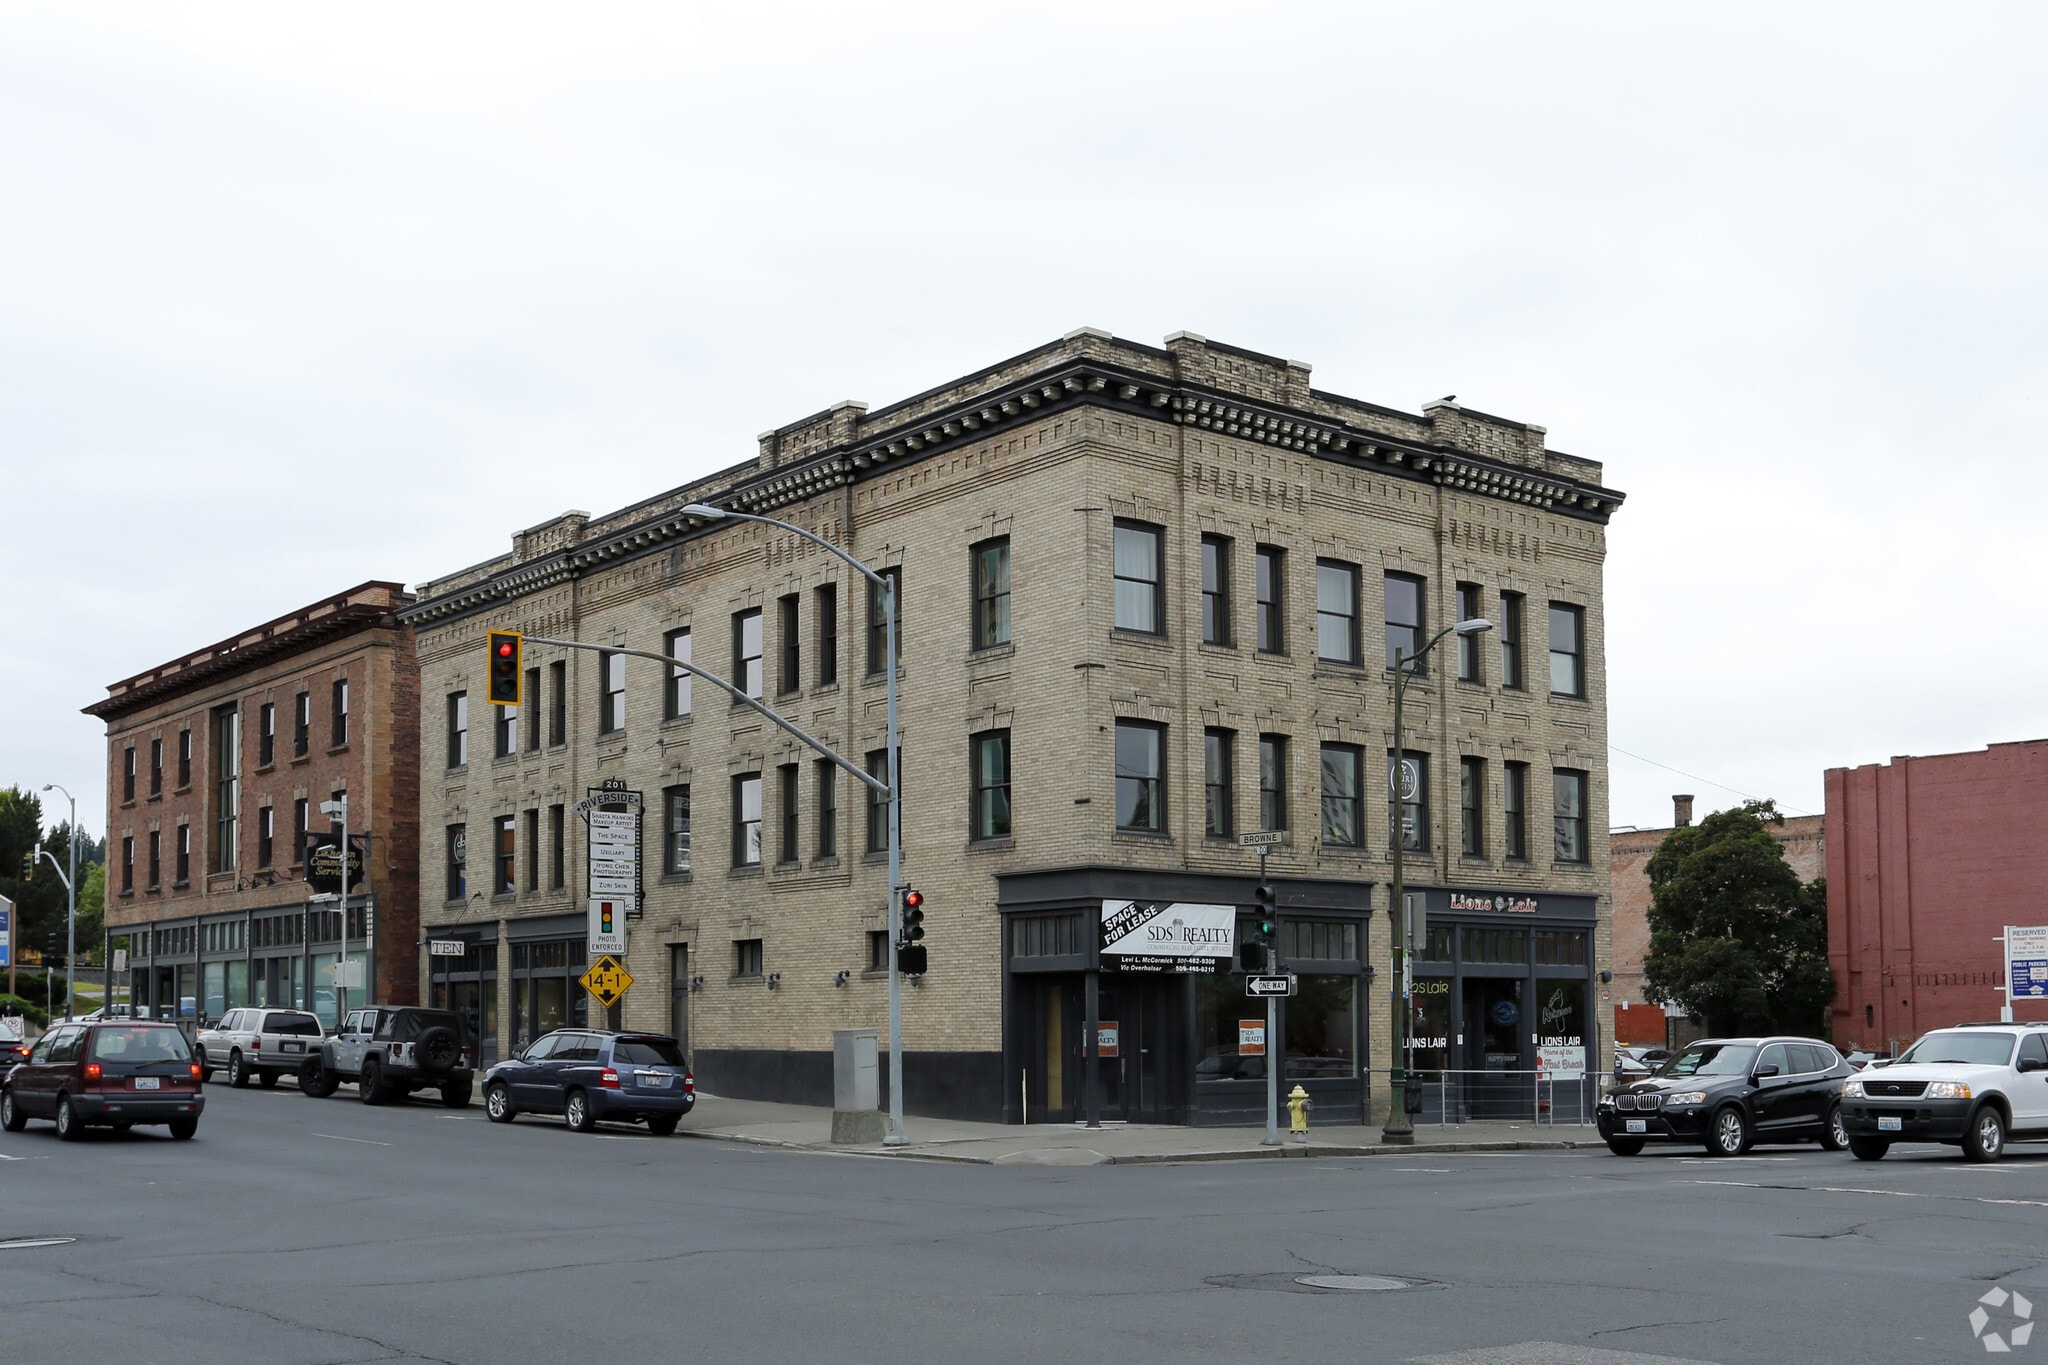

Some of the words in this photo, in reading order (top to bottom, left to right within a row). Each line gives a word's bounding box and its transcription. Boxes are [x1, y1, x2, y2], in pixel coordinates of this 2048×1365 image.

[581, 793, 634, 811] RIVERSIDE
[1244, 833, 1278, 844] BROWNE
[1450, 893, 1492, 910] Lions
[1508, 897, 1537, 912] Lair
[1105, 904, 1137, 931] SPACE
[1104, 929, 1126, 945] FOR
[1126, 904, 1158, 932] LEASE
[1147, 926, 1173, 941] SDS
[1183, 926, 1231, 945] REALTY
[433, 942, 463, 954] TEN
[1259, 981, 1271, 990] ONE
[1272, 981, 1284, 989] WAY
[1428, 1037, 1446, 1048] LAIR
[1541, 1036, 1563, 1047] LIONS
[1564, 1036, 1580, 1046] LAIR
[1560, 1049, 1565, 1057] of
[1544, 1059, 1561, 1071] Fast
